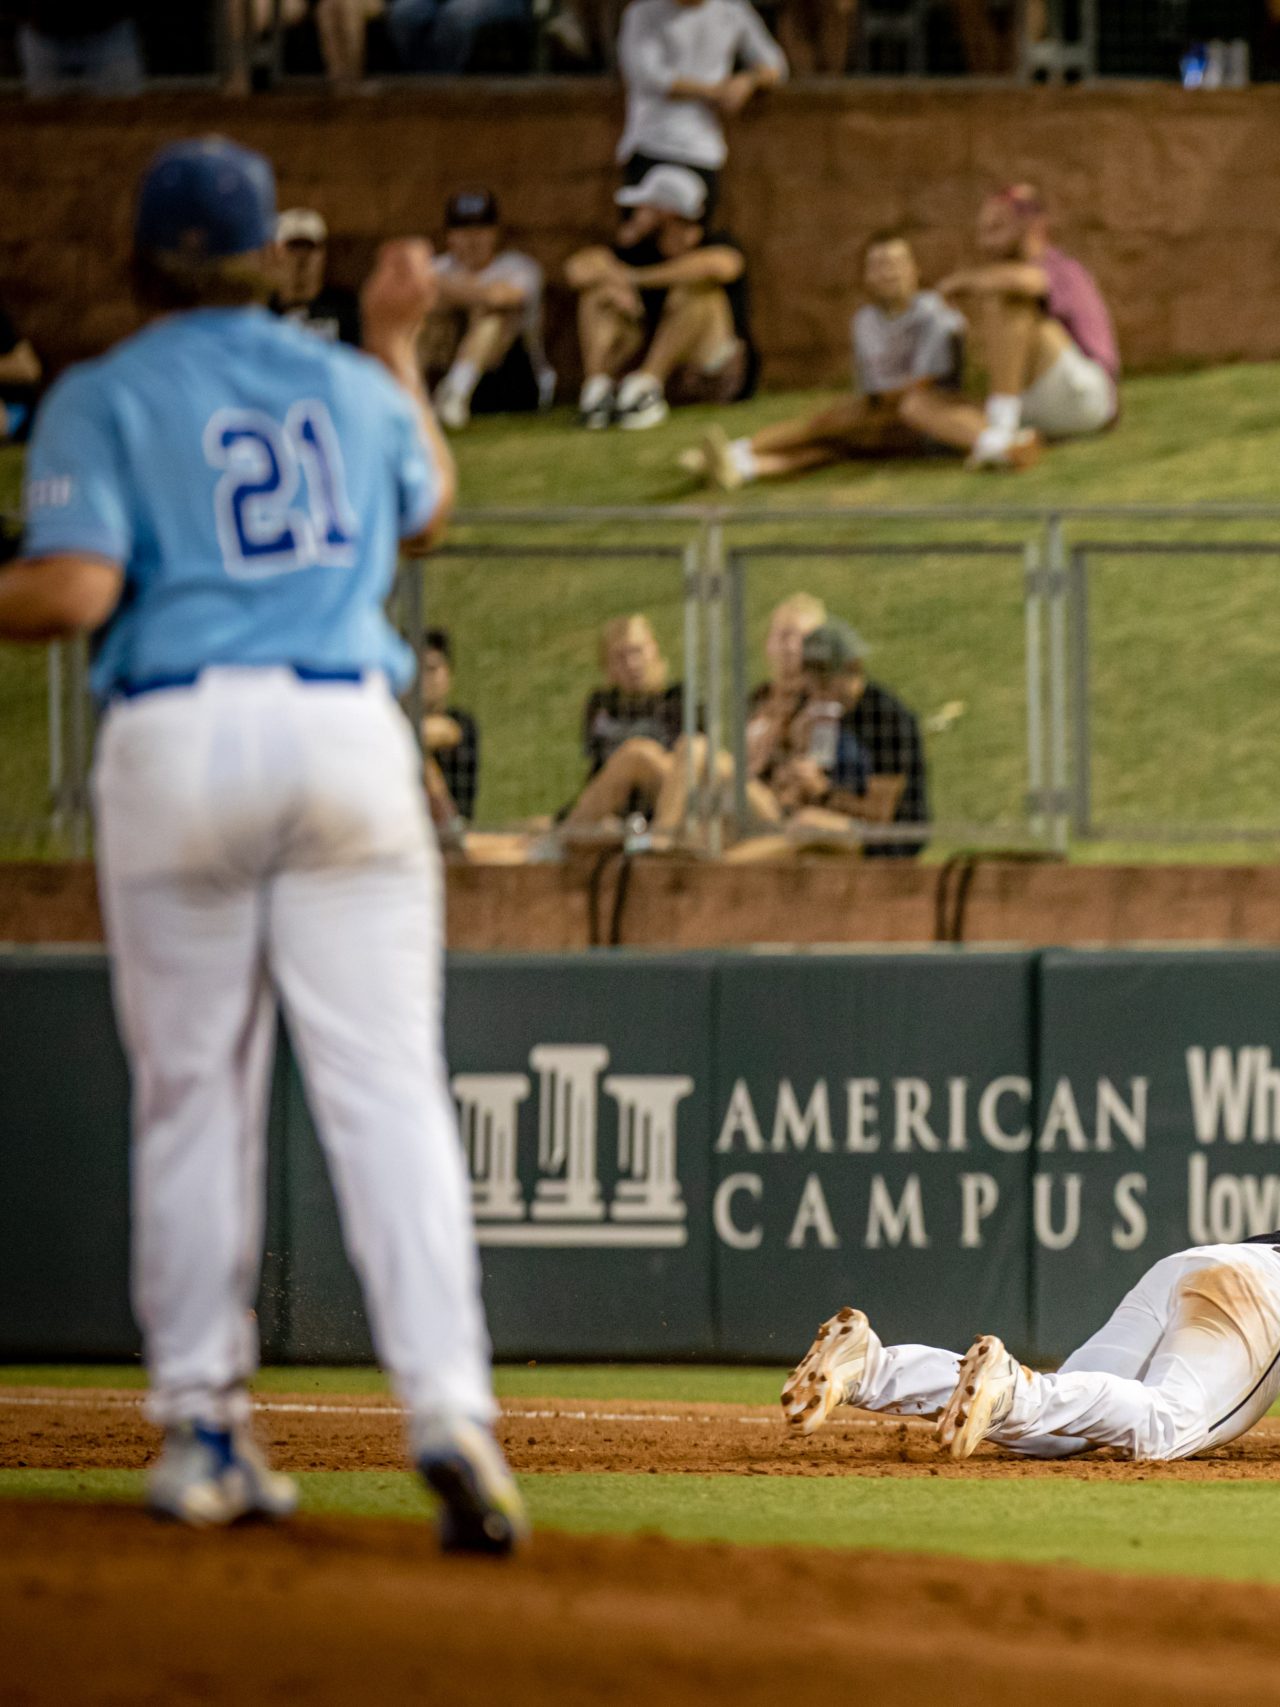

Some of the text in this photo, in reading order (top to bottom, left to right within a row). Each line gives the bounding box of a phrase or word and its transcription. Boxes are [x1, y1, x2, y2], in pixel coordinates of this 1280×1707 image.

[203, 398, 356, 579] 21
[713, 1075, 1149, 1153] AMERICAN
[712, 1172, 1149, 1250] CAMPUS
